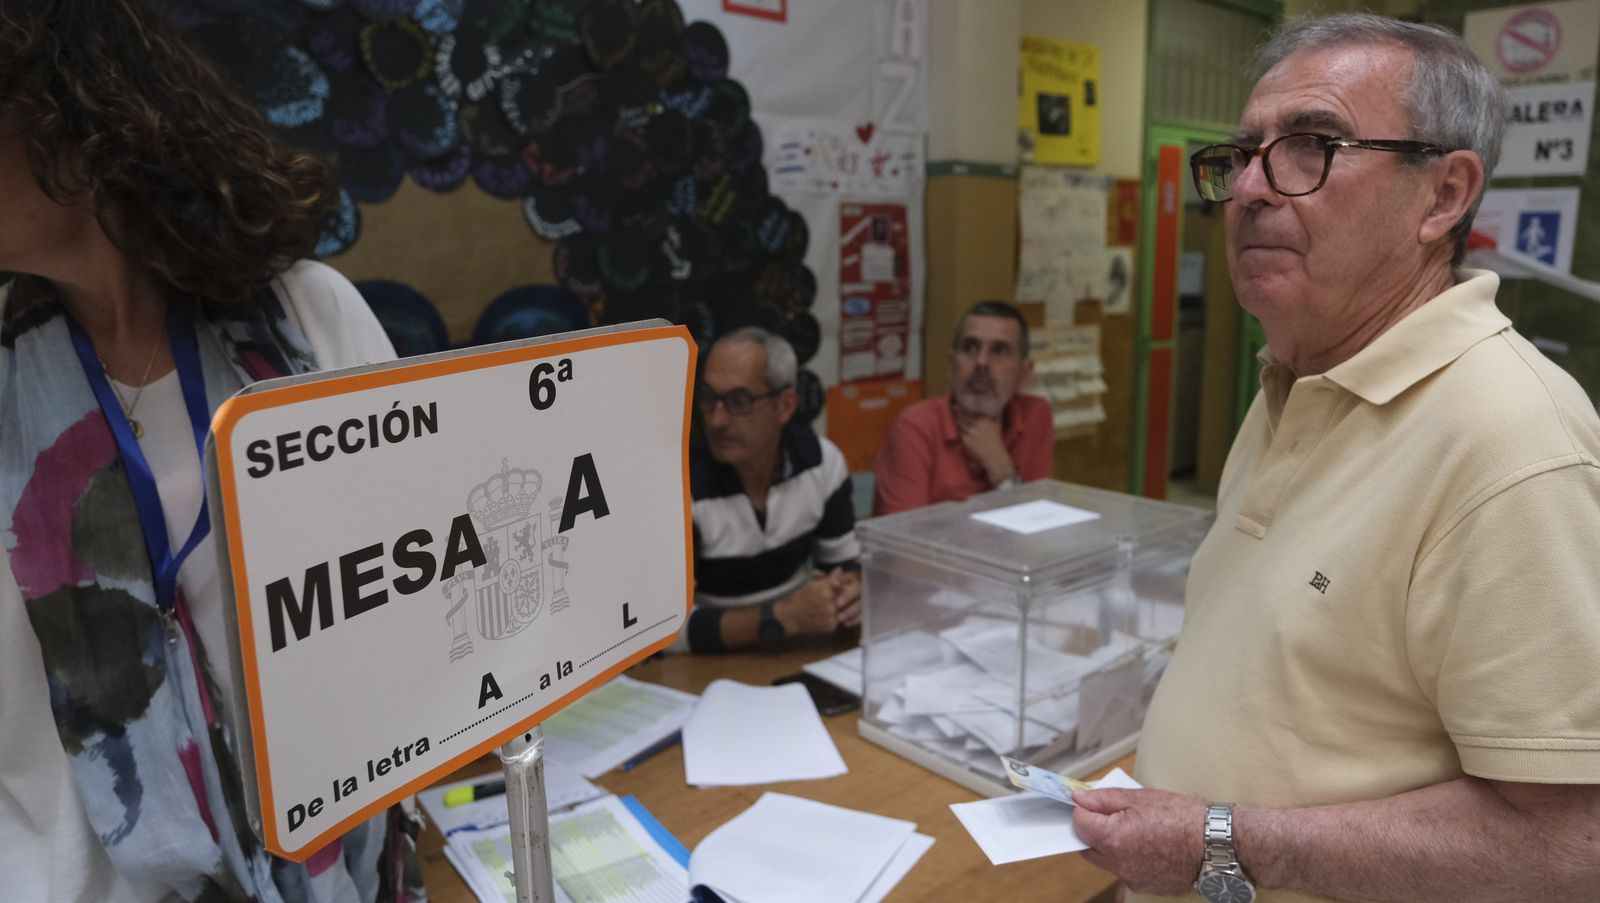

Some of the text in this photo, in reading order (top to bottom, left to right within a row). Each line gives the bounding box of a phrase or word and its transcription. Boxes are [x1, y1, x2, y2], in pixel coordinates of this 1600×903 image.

[1507, 98, 1583, 123] ALERA
[246, 401, 439, 479] SECCIÓN
[265, 452, 611, 653] MESA A
[287, 602, 638, 833] De la letra A a la L
